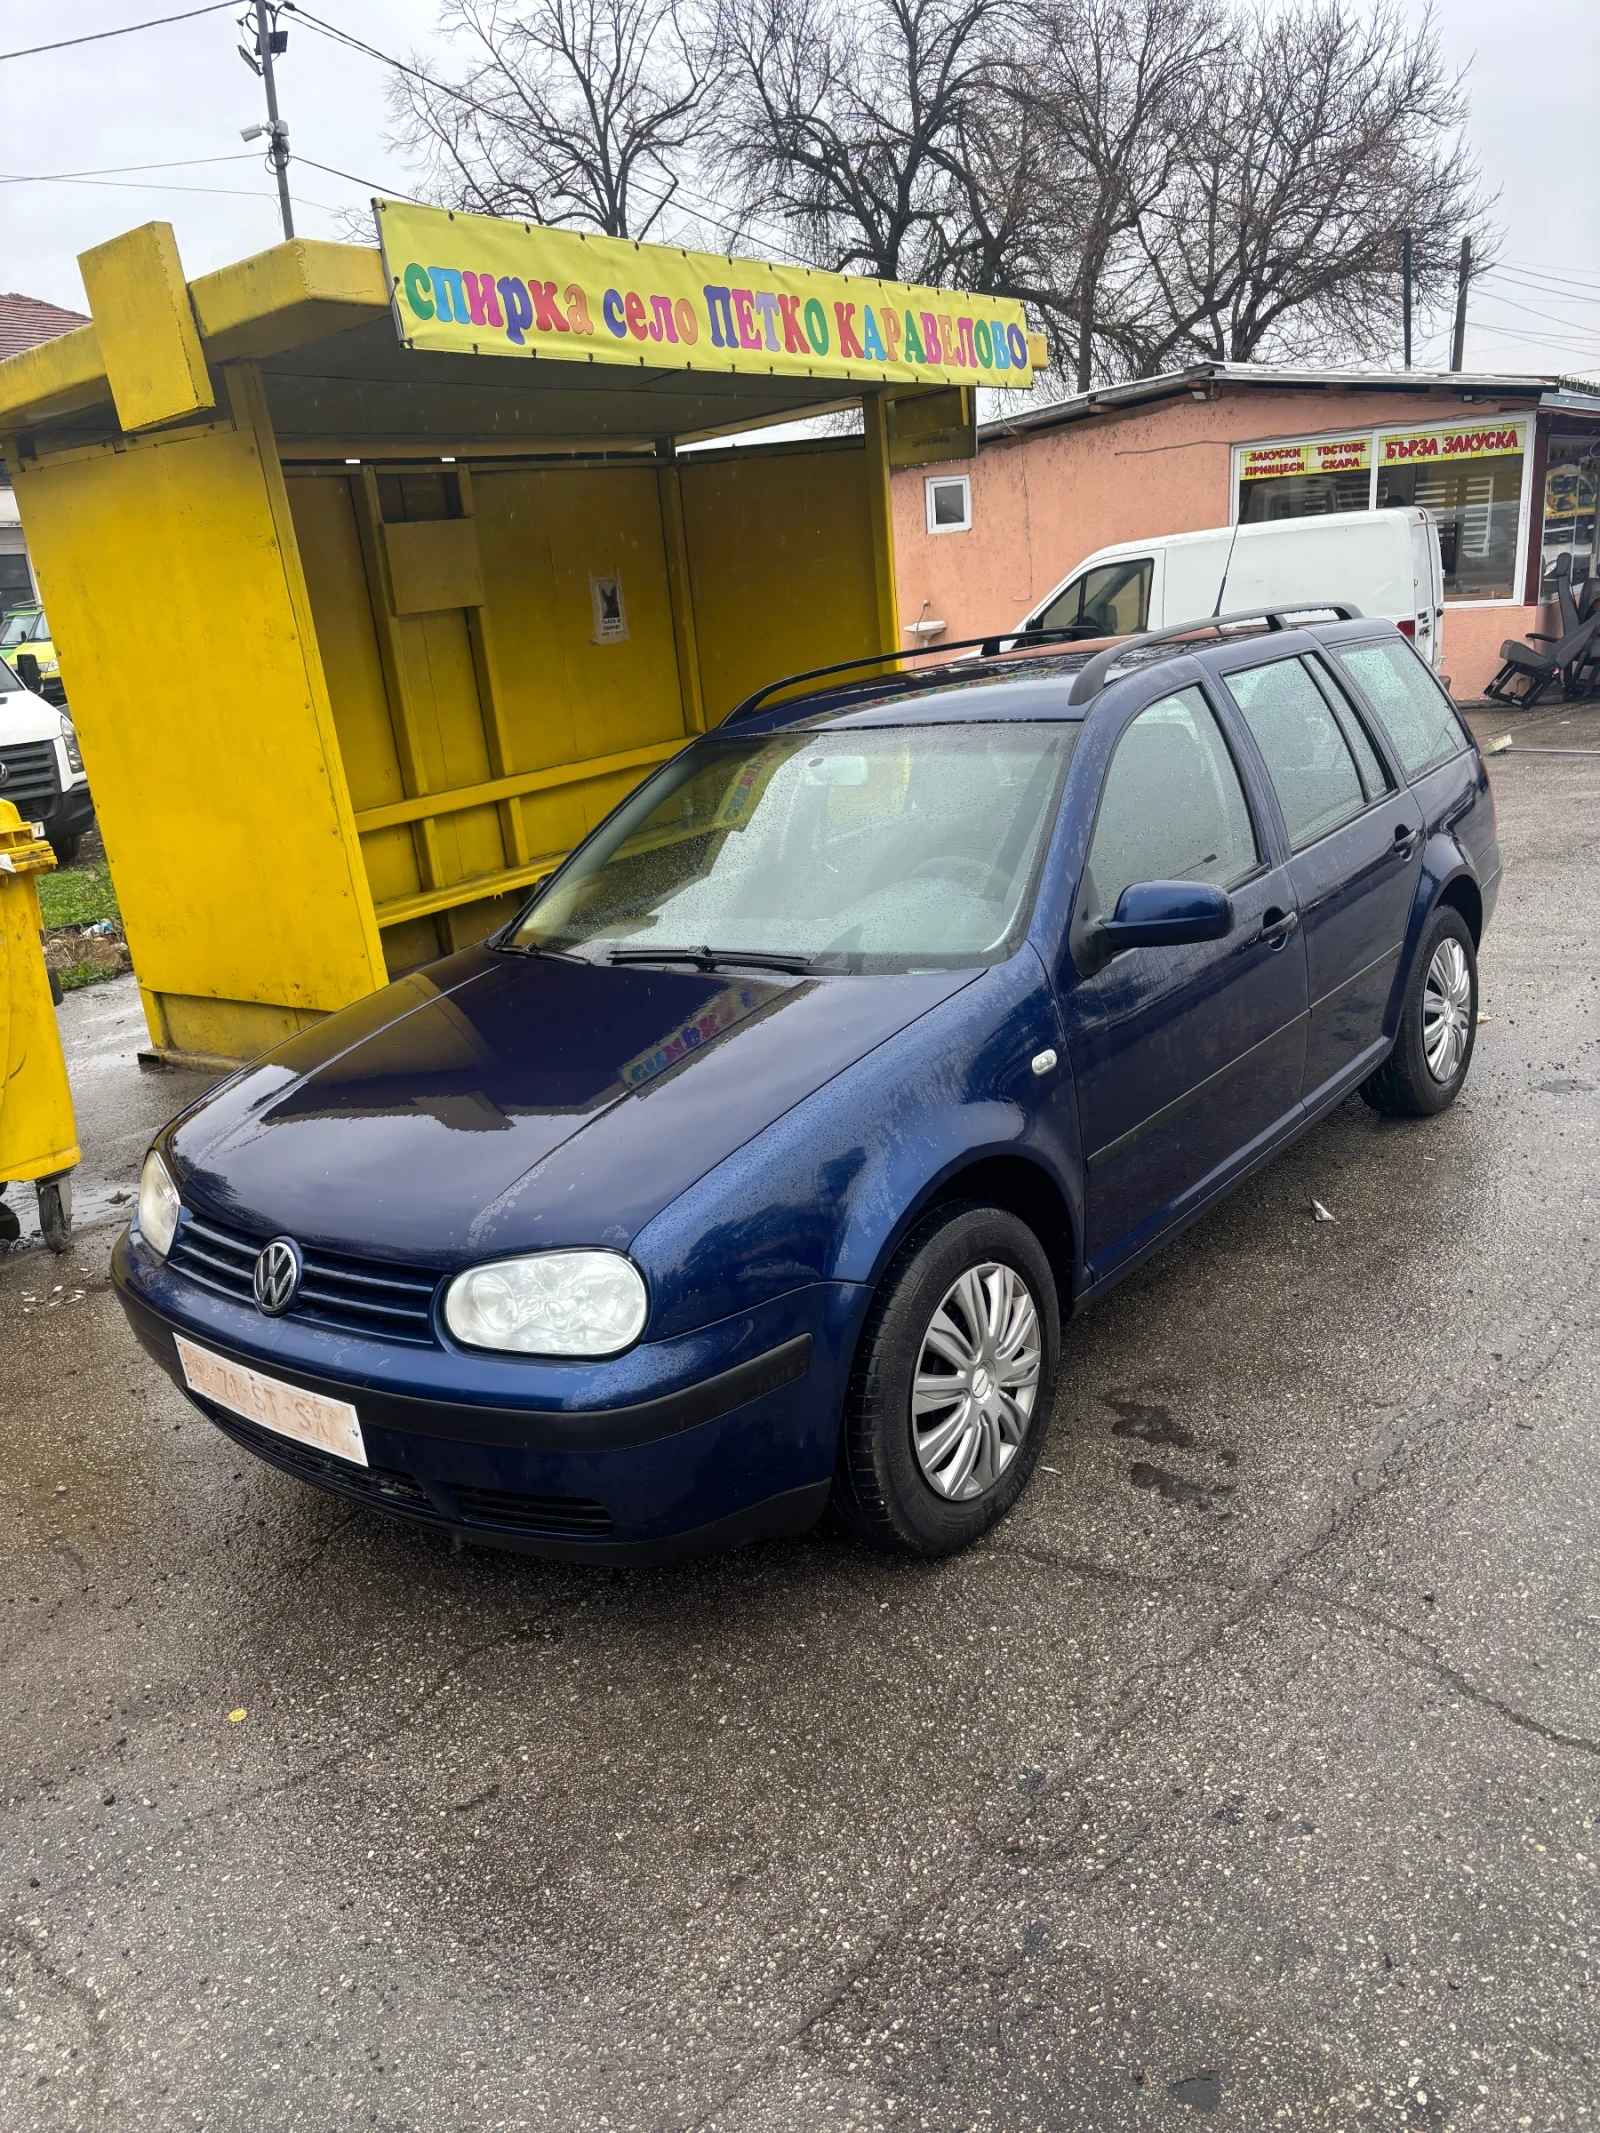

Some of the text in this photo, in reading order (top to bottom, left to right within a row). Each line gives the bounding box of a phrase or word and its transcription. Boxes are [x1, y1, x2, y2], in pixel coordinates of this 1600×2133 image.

[404, 263, 1027, 370] спирка село ПЕТКО КАРАВЕЛОВО
[1316, 442, 1367, 456] ТОСТОВЕ
[1386, 430, 1518, 459] БЪРЗА ЗАКУСКА
[1249, 448, 1301, 461] ЗАКУСКИ
[1245, 462, 1305, 476] ПРИНЦЕСИ
[1321, 457, 1360, 470] СКАРА
